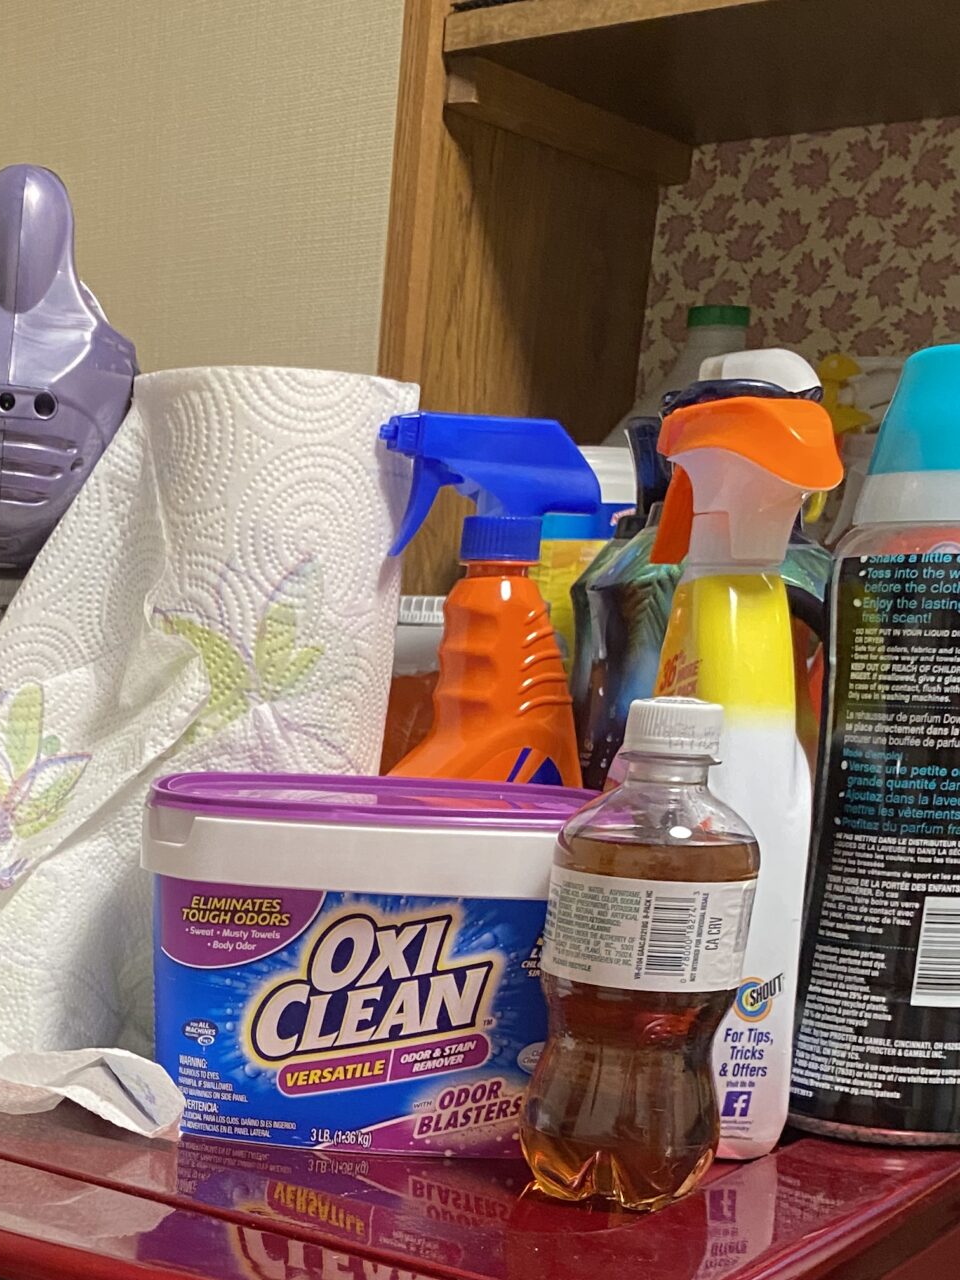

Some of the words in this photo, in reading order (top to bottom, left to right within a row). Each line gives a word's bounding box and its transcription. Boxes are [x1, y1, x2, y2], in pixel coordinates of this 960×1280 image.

[867, 567, 892, 579] Toss
[894, 567, 919, 579] into
[922, 566, 945, 579] the
[864, 581, 901, 593] before
[905, 581, 927, 593] the
[863, 597, 893, 612] Enjoy
[896, 597, 918, 609] the
[862, 611, 888, 623] fresh
[892, 612, 932, 623] scent!
[909, 712, 941, 724] parfum
[874, 723, 924, 734] directement
[926, 725, 949, 736] dans
[922, 737, 935, 747] de
[848, 761, 881, 774] Versez
[885, 764, 908, 775] une
[911, 764, 948, 778] petite
[847, 775, 883, 788] grande
[886, 778, 937, 791] quantité
[845, 789, 884, 803] Ajoutez
[885, 792, 915, 805] dans
[918, 793, 929, 805] la
[843, 804, 876, 815] mettre
[878, 806, 895, 817] les
[842, 817, 880, 831] Profitez
[882, 820, 897, 832] du
[900, 822, 944, 835] parfum
[191, 896, 282, 912] ELIMINATES
[182, 908, 231, 924] TOUGH
[233, 912, 291, 927] ODORS
[190, 926, 215, 937] Sweat
[222, 928, 248, 940] Musty
[251, 930, 281, 940] Towels
[707, 916, 723, 936] CRV
[212, 940, 235, 952] Body
[235, 941, 257, 951] Odor
[311, 916, 447, 991] OXI
[705, 940, 720, 951] CA
[749, 972, 784, 1007] SHOUT
[255, 966, 490, 1058] CLEAN
[724, 1028, 744, 1043] For
[747, 1028, 774, 1046] Tips,
[400, 1049, 432, 1064] ODOR
[432, 1047, 442, 1058] &
[443, 1040, 478, 1056] STAIN
[730, 1046, 764, 1061] Tricks
[412, 1054, 464, 1073] REMOVER
[719, 1063, 728, 1077] &
[732, 1062, 768, 1077] Offers
[285, 1060, 386, 1088] VERSATILE
[413, 1101, 433, 1109] WITH
[438, 1080, 503, 1110] ODOR
[416, 1094, 523, 1136] BLASTERS
[310, 1128, 317, 1141] 3
[318, 1128, 332, 1143] LB.
[357, 1131, 373, 1148] kg)
